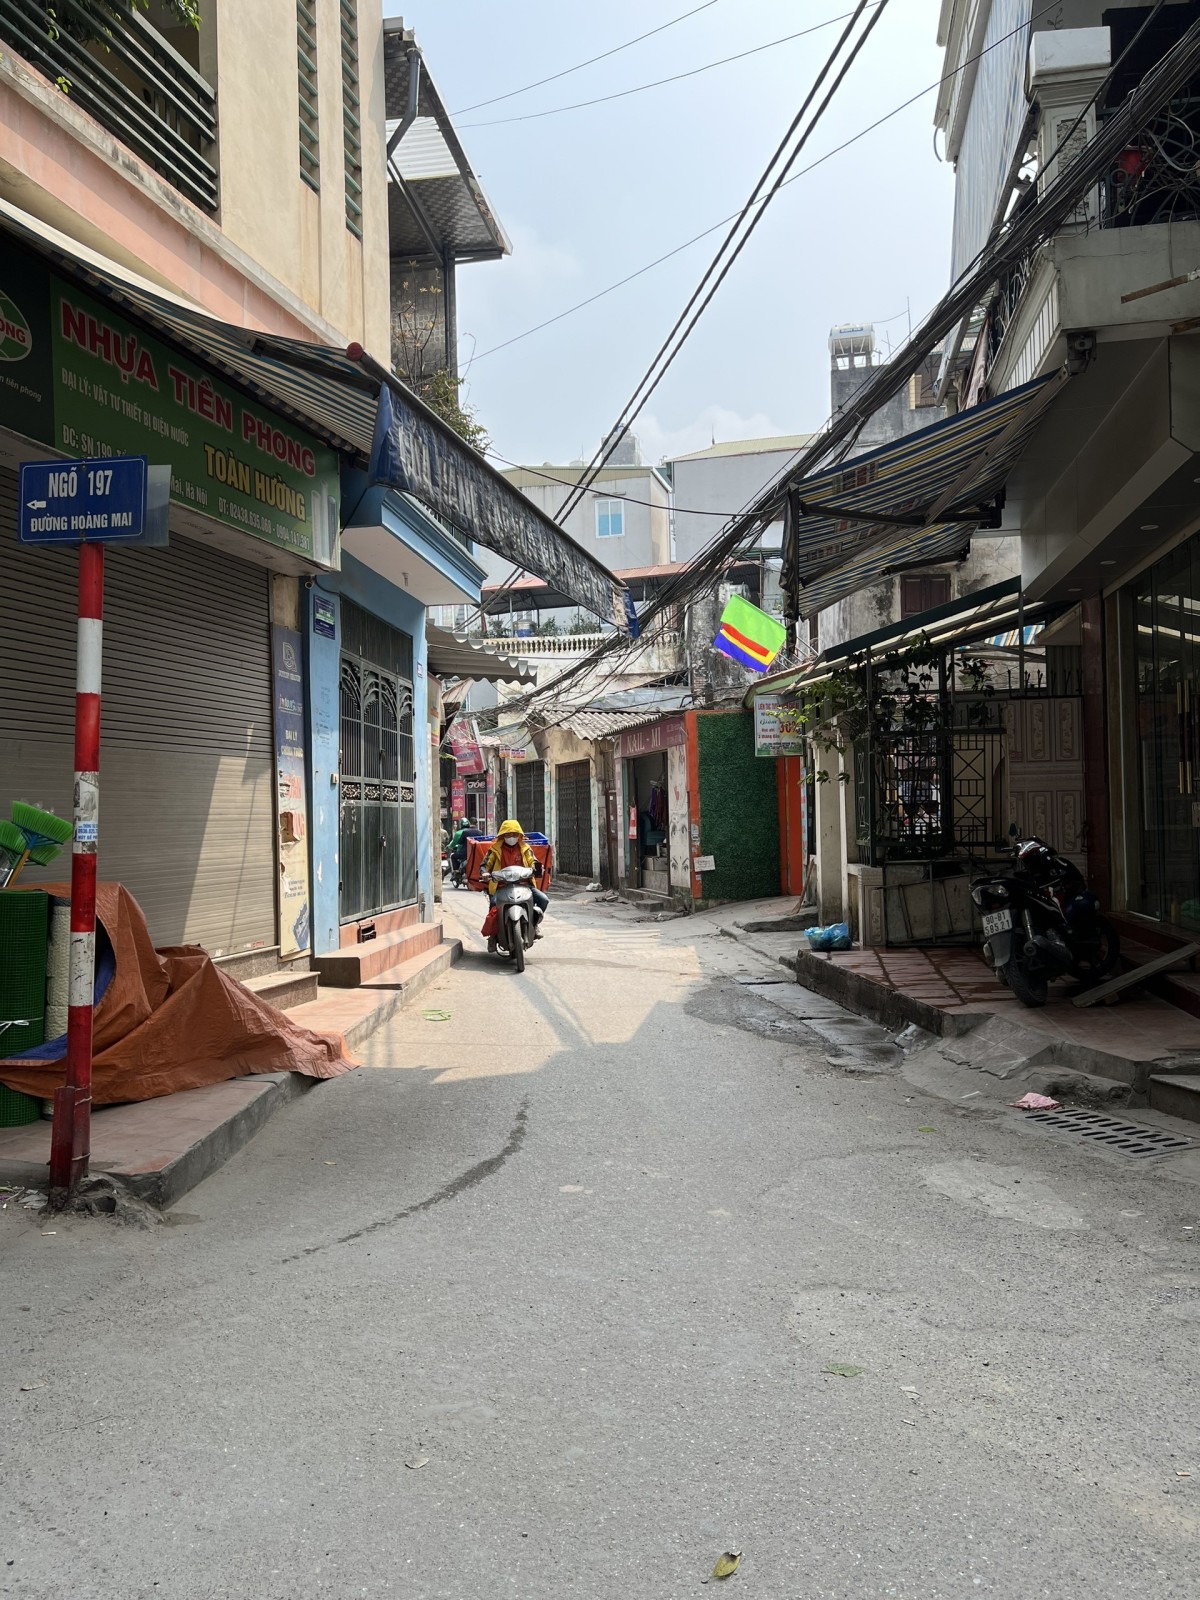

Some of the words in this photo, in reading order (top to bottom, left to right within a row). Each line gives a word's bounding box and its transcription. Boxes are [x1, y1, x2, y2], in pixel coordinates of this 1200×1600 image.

[61, 298, 159, 391] NHỰA
[168, 365, 233, 433] TIỀN
[242, 408, 315, 477] PHONG
[62, 368, 77, 391] ĐẠI
[79, 376, 92, 397] LÝ:
[93, 384, 108, 406] VẬT
[109, 392, 121, 412] TƯ
[121, 401, 142, 423] THIẾT
[143, 411, 152, 431] BỊ
[152, 417, 170, 438] ĐIỆN
[170, 423, 189, 448] NƯỚC
[62, 424, 79, 449] ĐC:
[81, 433, 94, 456] SN
[48, 466, 78, 498] NGÕ
[88, 470, 113, 496] 197
[185, 481, 194, 500] Hà
[196, 486, 208, 508] Nội
[204, 442, 251, 497] TOÀN
[254, 469, 306, 522] HƯỜNG
[218, 497, 229, 515] ĐT:
[30, 513, 68, 532] ĐƯỜNG
[71, 511, 108, 530] HOÀNG
[111, 512, 132, 527] MAI
[627, 732, 645, 753] NAIL
[651, 727, 661, 748] MI
[984, 919, 1010, 935] 585.21
